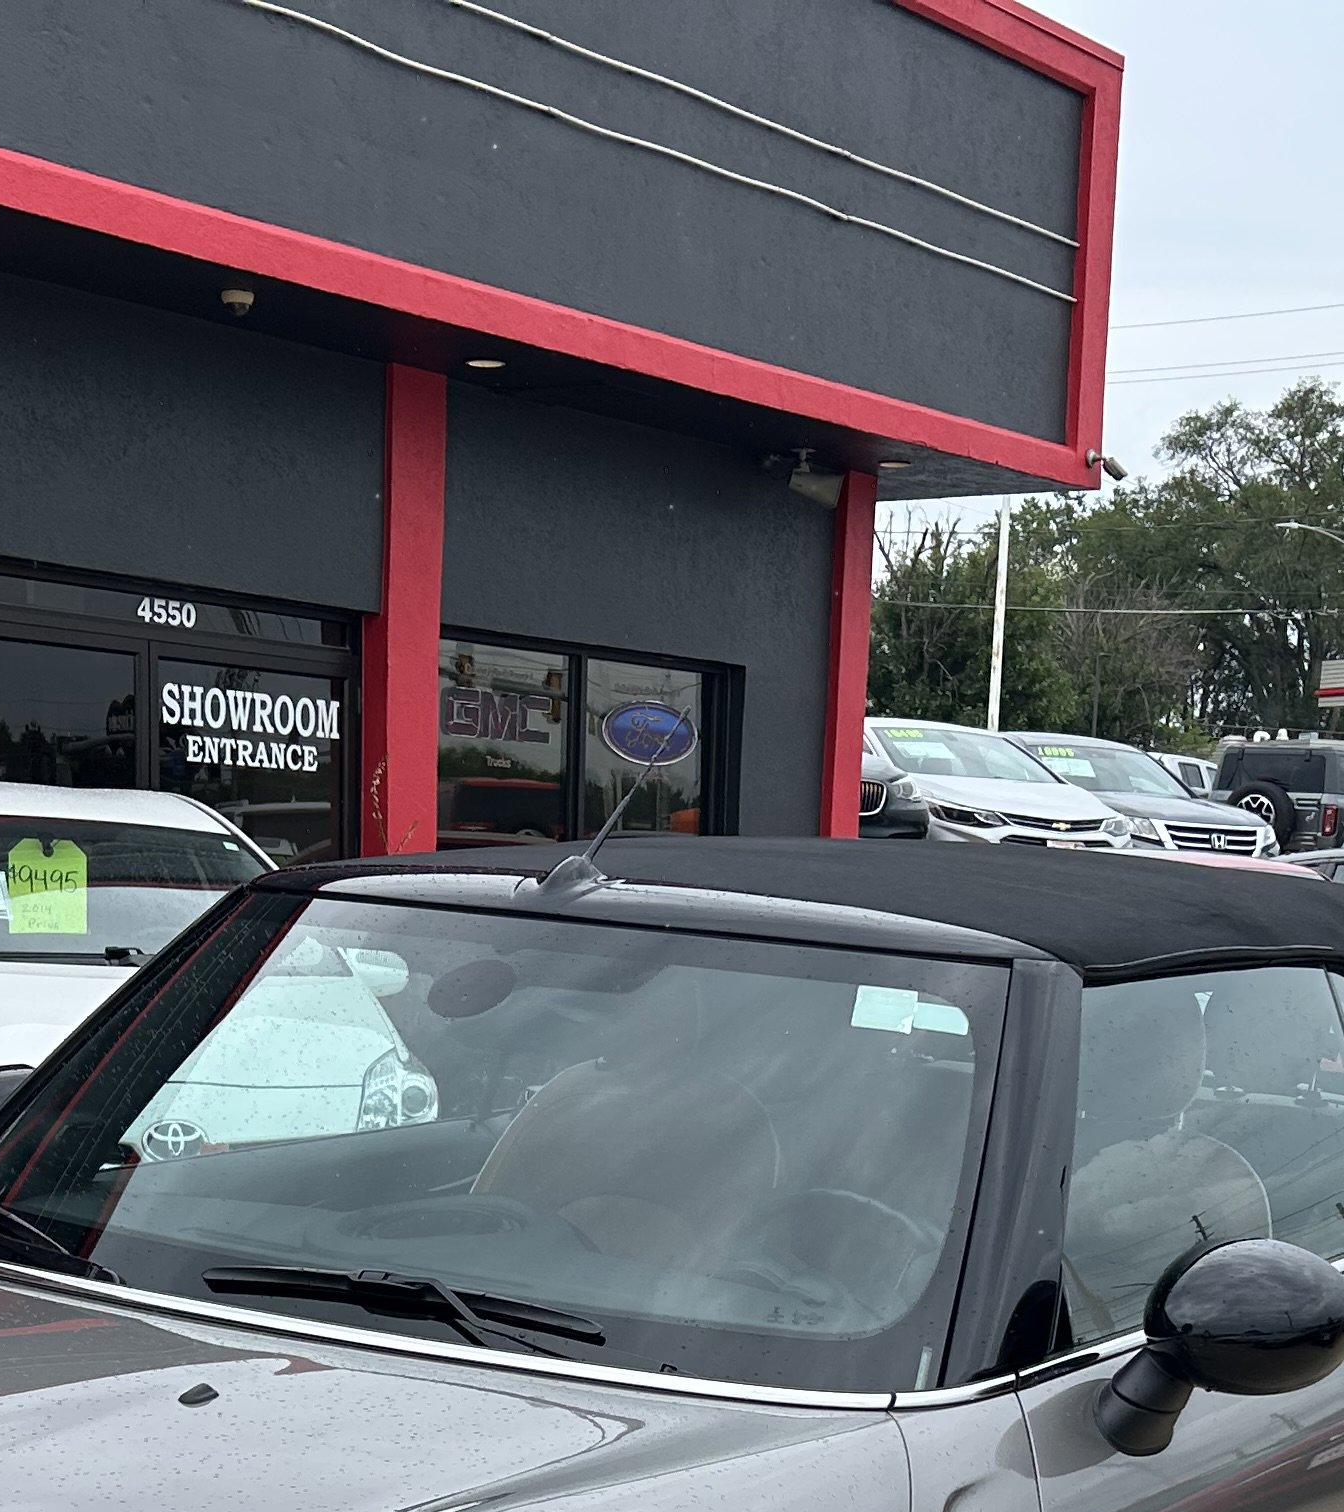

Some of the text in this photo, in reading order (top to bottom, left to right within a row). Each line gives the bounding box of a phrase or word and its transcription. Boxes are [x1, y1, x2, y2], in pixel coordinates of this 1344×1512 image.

[137, 597, 197, 629] 4550
[162, 682, 341, 740] SHOWROOM
[442, 686, 553, 745] GMC
[186, 733, 319, 773] ENTRANCE
